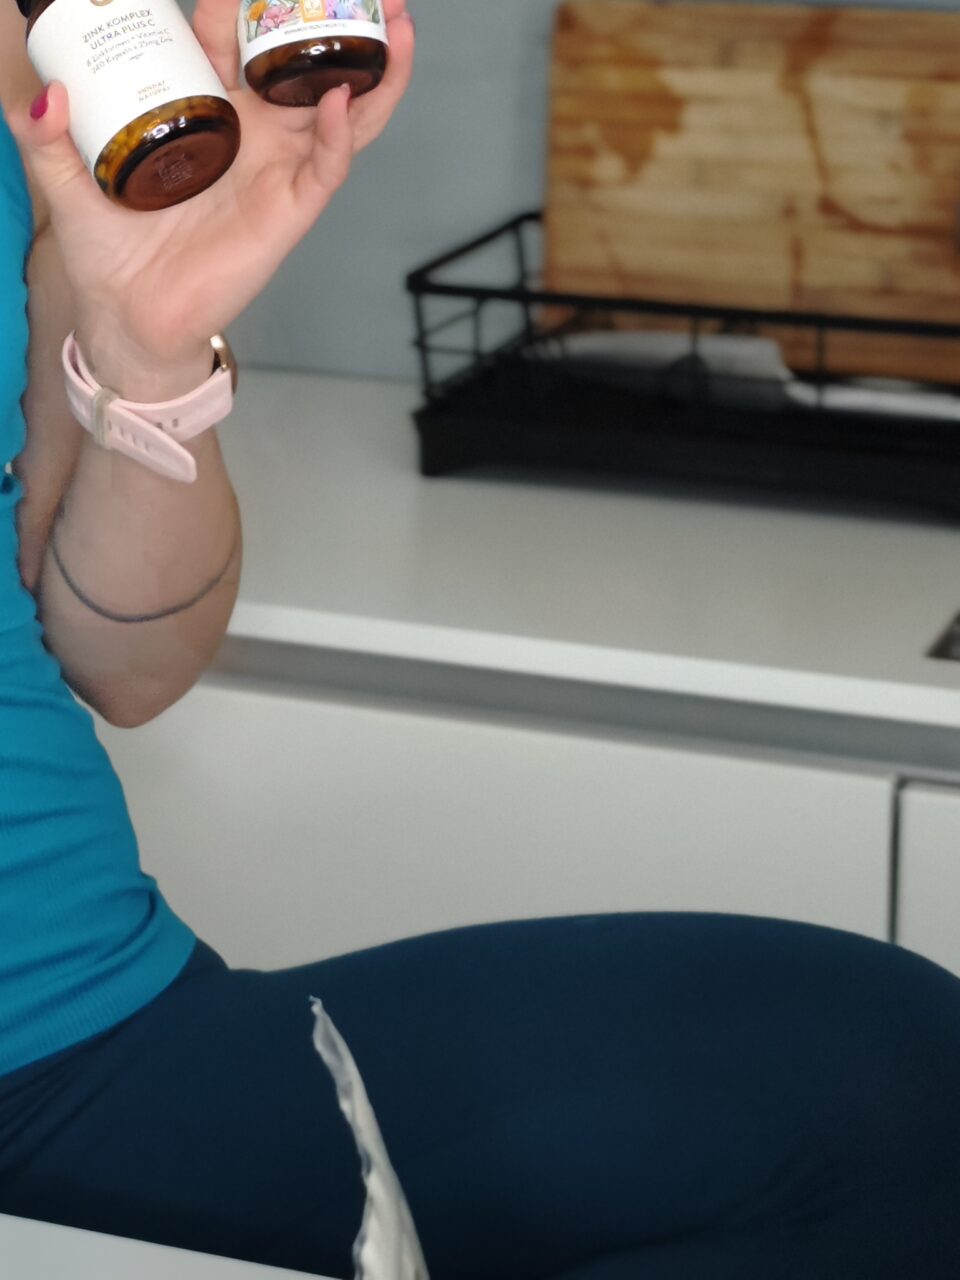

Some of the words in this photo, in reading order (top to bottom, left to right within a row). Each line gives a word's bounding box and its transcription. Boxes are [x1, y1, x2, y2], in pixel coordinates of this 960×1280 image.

[82, 24, 105, 43] ZINK
[106, 9, 152, 29] KOMPLEX
[90, 30, 121, 50] ULTRA
[123, 21, 147, 35] PLUS
[147, 19, 156, 27] C
